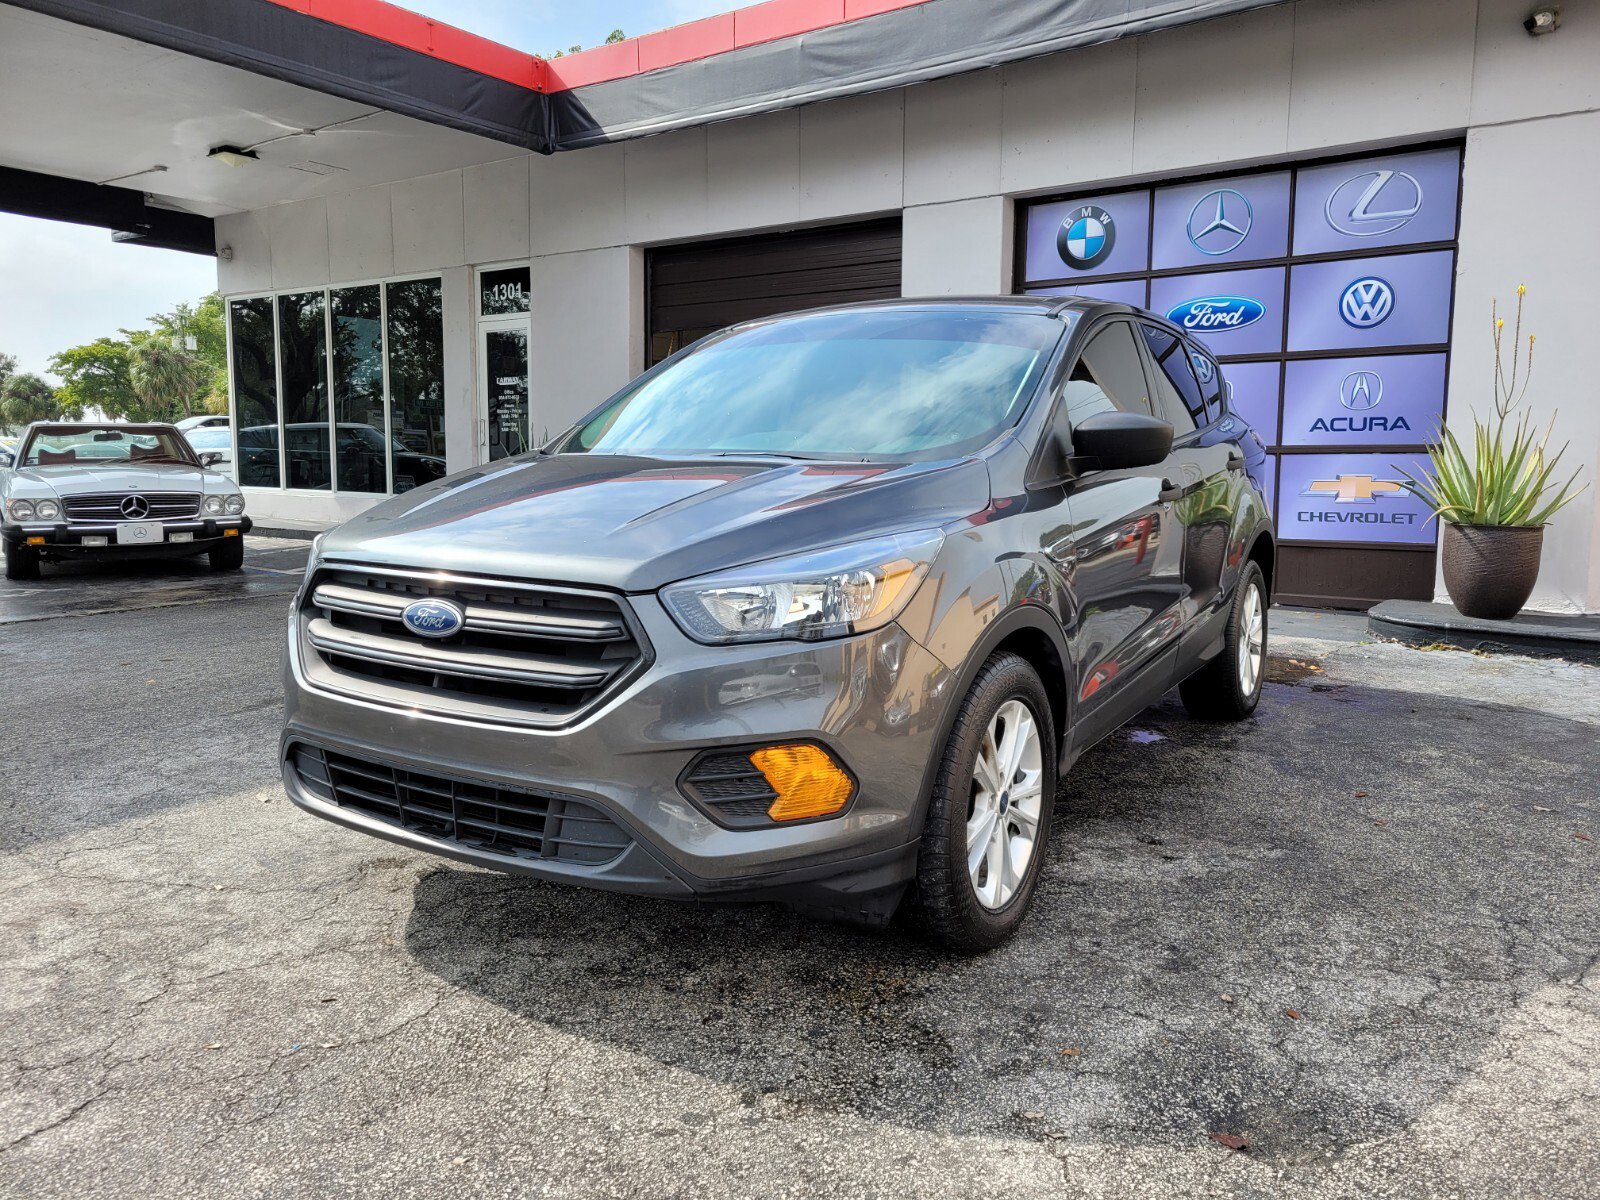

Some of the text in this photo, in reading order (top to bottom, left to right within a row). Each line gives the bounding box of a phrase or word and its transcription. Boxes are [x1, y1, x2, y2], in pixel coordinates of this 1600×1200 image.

[1062, 206, 1111, 229] BMW
[493, 282, 521, 300] 1301
[1183, 301, 1245, 327] Ford
[1309, 416, 1411, 432] ACURA
[1297, 511, 1418, 525] CHEVROLET
[413, 607, 446, 628] Ford
